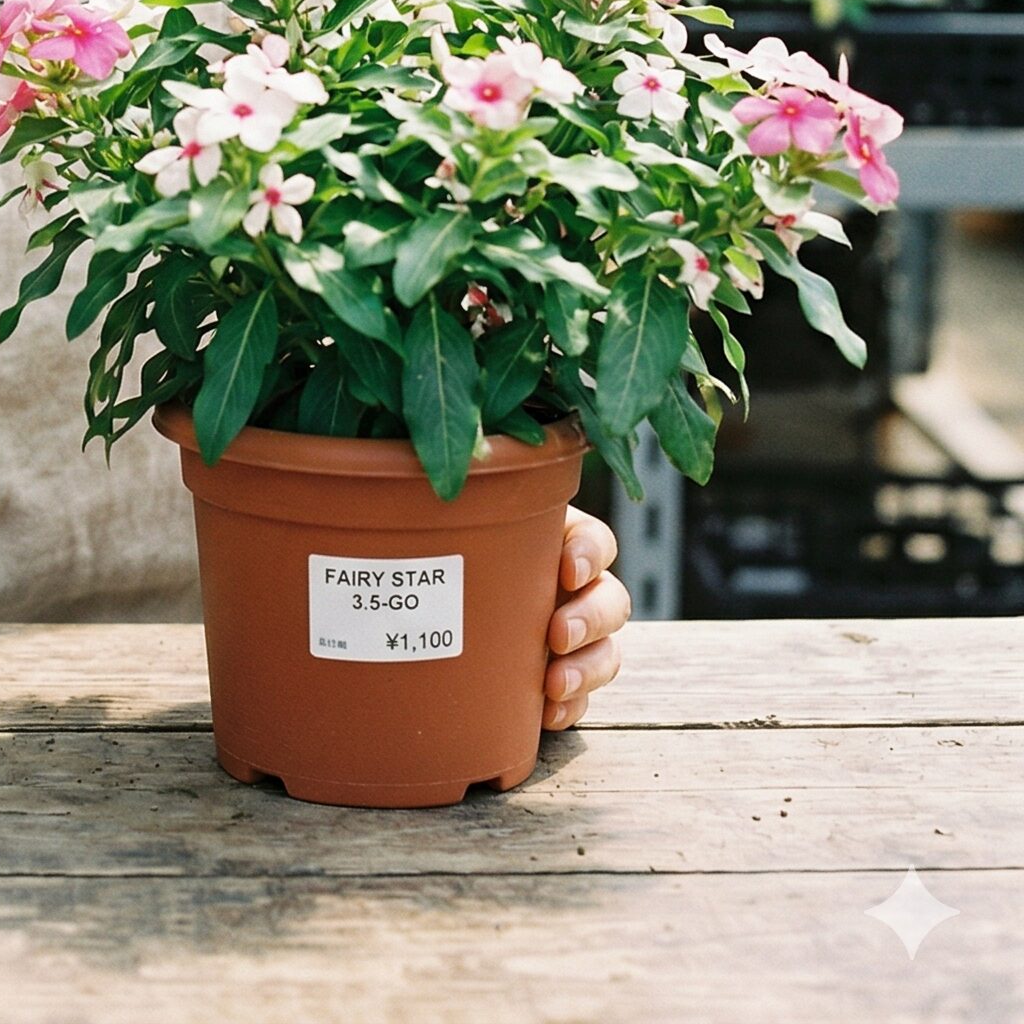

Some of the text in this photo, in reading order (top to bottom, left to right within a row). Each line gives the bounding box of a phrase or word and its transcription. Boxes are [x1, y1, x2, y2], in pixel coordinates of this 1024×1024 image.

[325, 568, 445, 588] FAIRY STAR
[352, 594, 419, 612] 3.5-GO
[386, 629, 453, 653] ¥1,100
